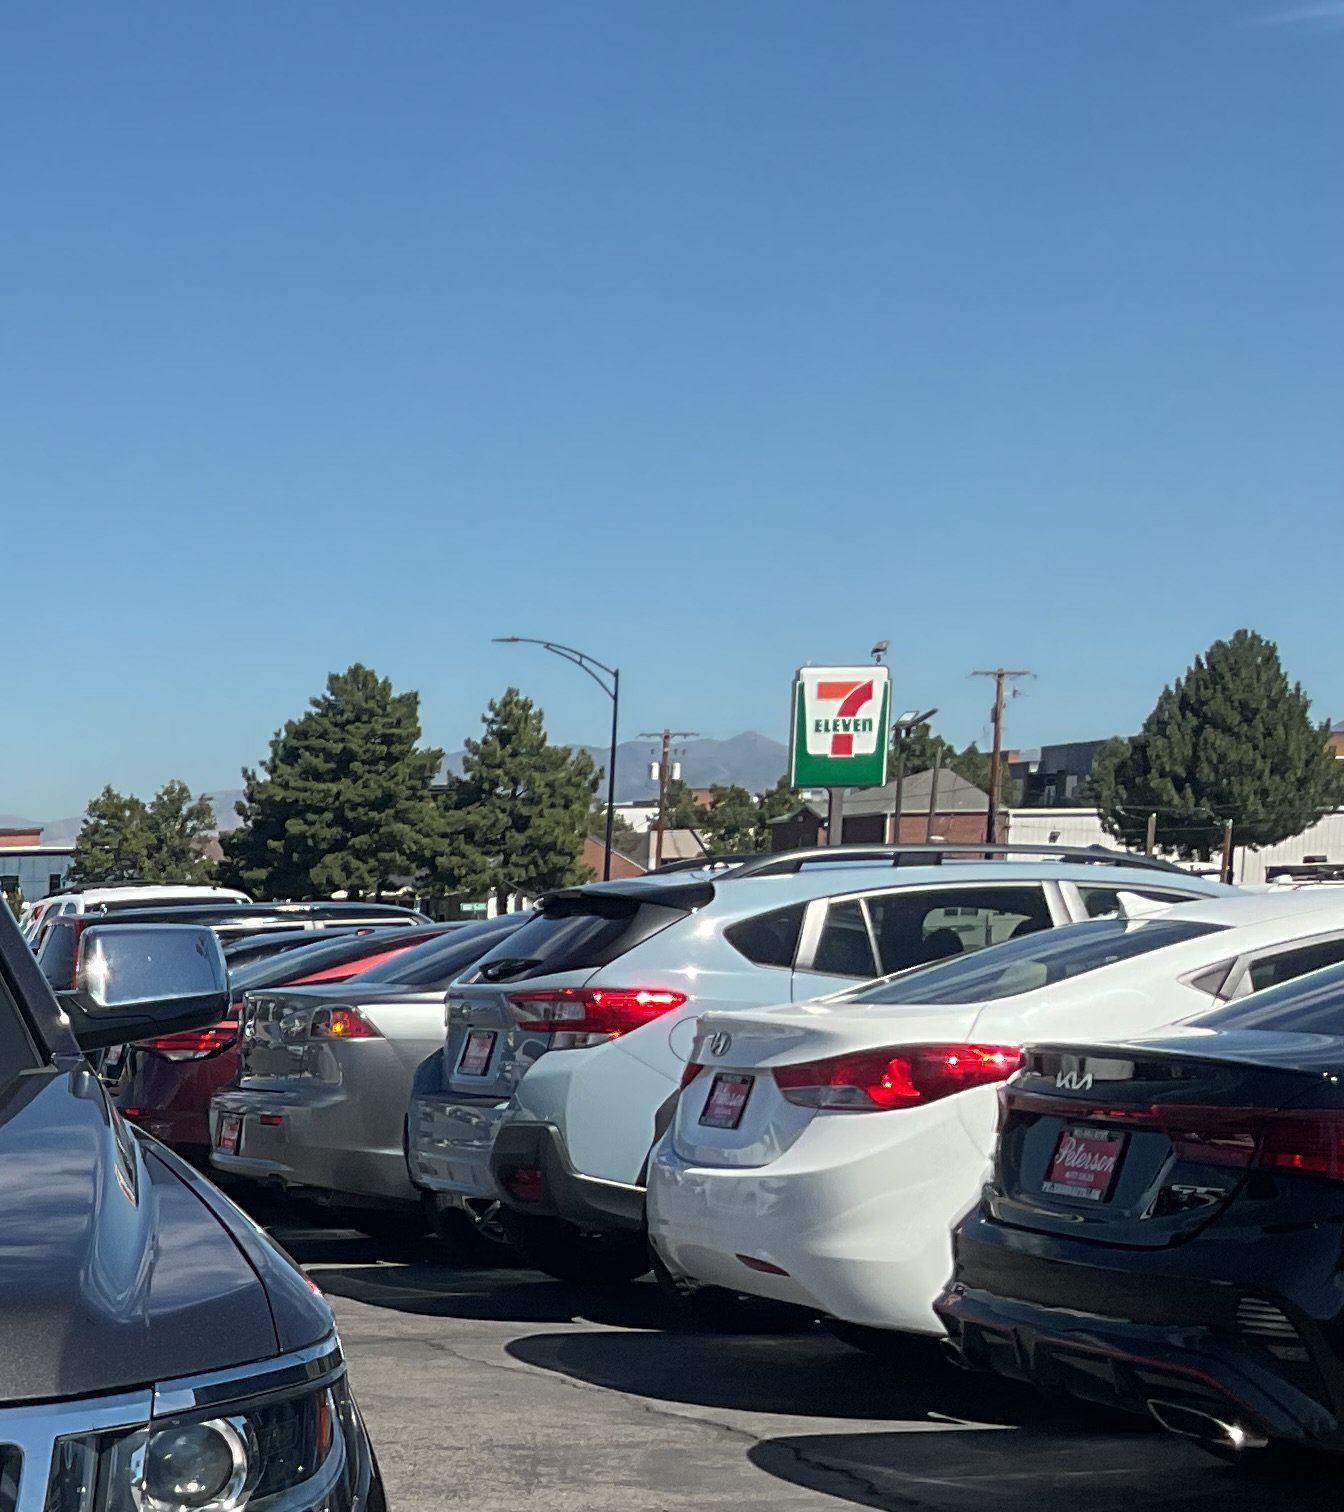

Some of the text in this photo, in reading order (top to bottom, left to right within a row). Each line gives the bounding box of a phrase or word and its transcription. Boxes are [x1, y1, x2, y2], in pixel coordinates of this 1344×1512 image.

[816, 679, 874, 756] 7
[1056, 1071, 1093, 1091] KIA
[1056, 1136, 1116, 1173] Peterson
